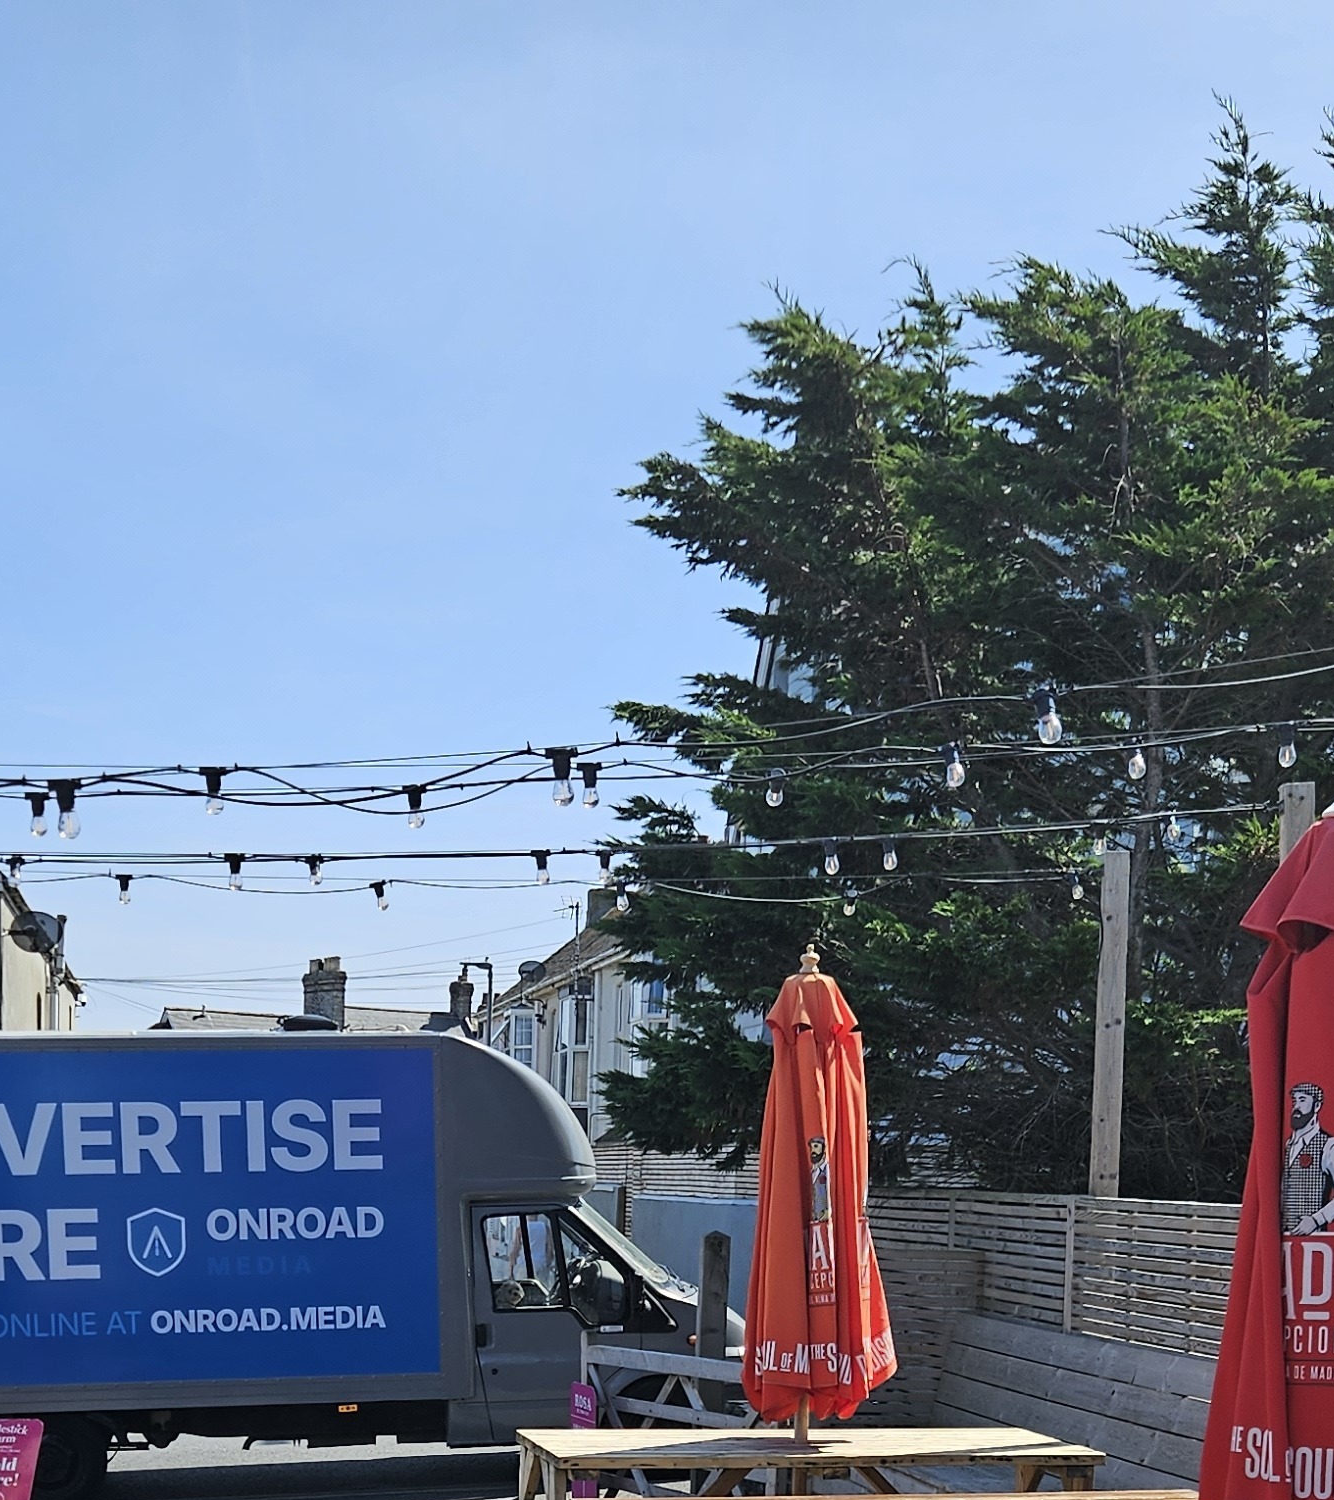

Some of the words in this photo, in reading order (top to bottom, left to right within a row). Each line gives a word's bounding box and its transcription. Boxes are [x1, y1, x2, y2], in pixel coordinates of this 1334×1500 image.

[207, 1206, 384, 1241] ONROAD
[207, 1255, 312, 1276] MEDIA
[106, 1311, 142, 1336] AT
[150, 1305, 386, 1334] ONROAD.MEDIA
[780, 1352, 794, 1370] OF
[810, 1344, 826, 1360] THE
[1293, 1365, 1305, 1380] DE
